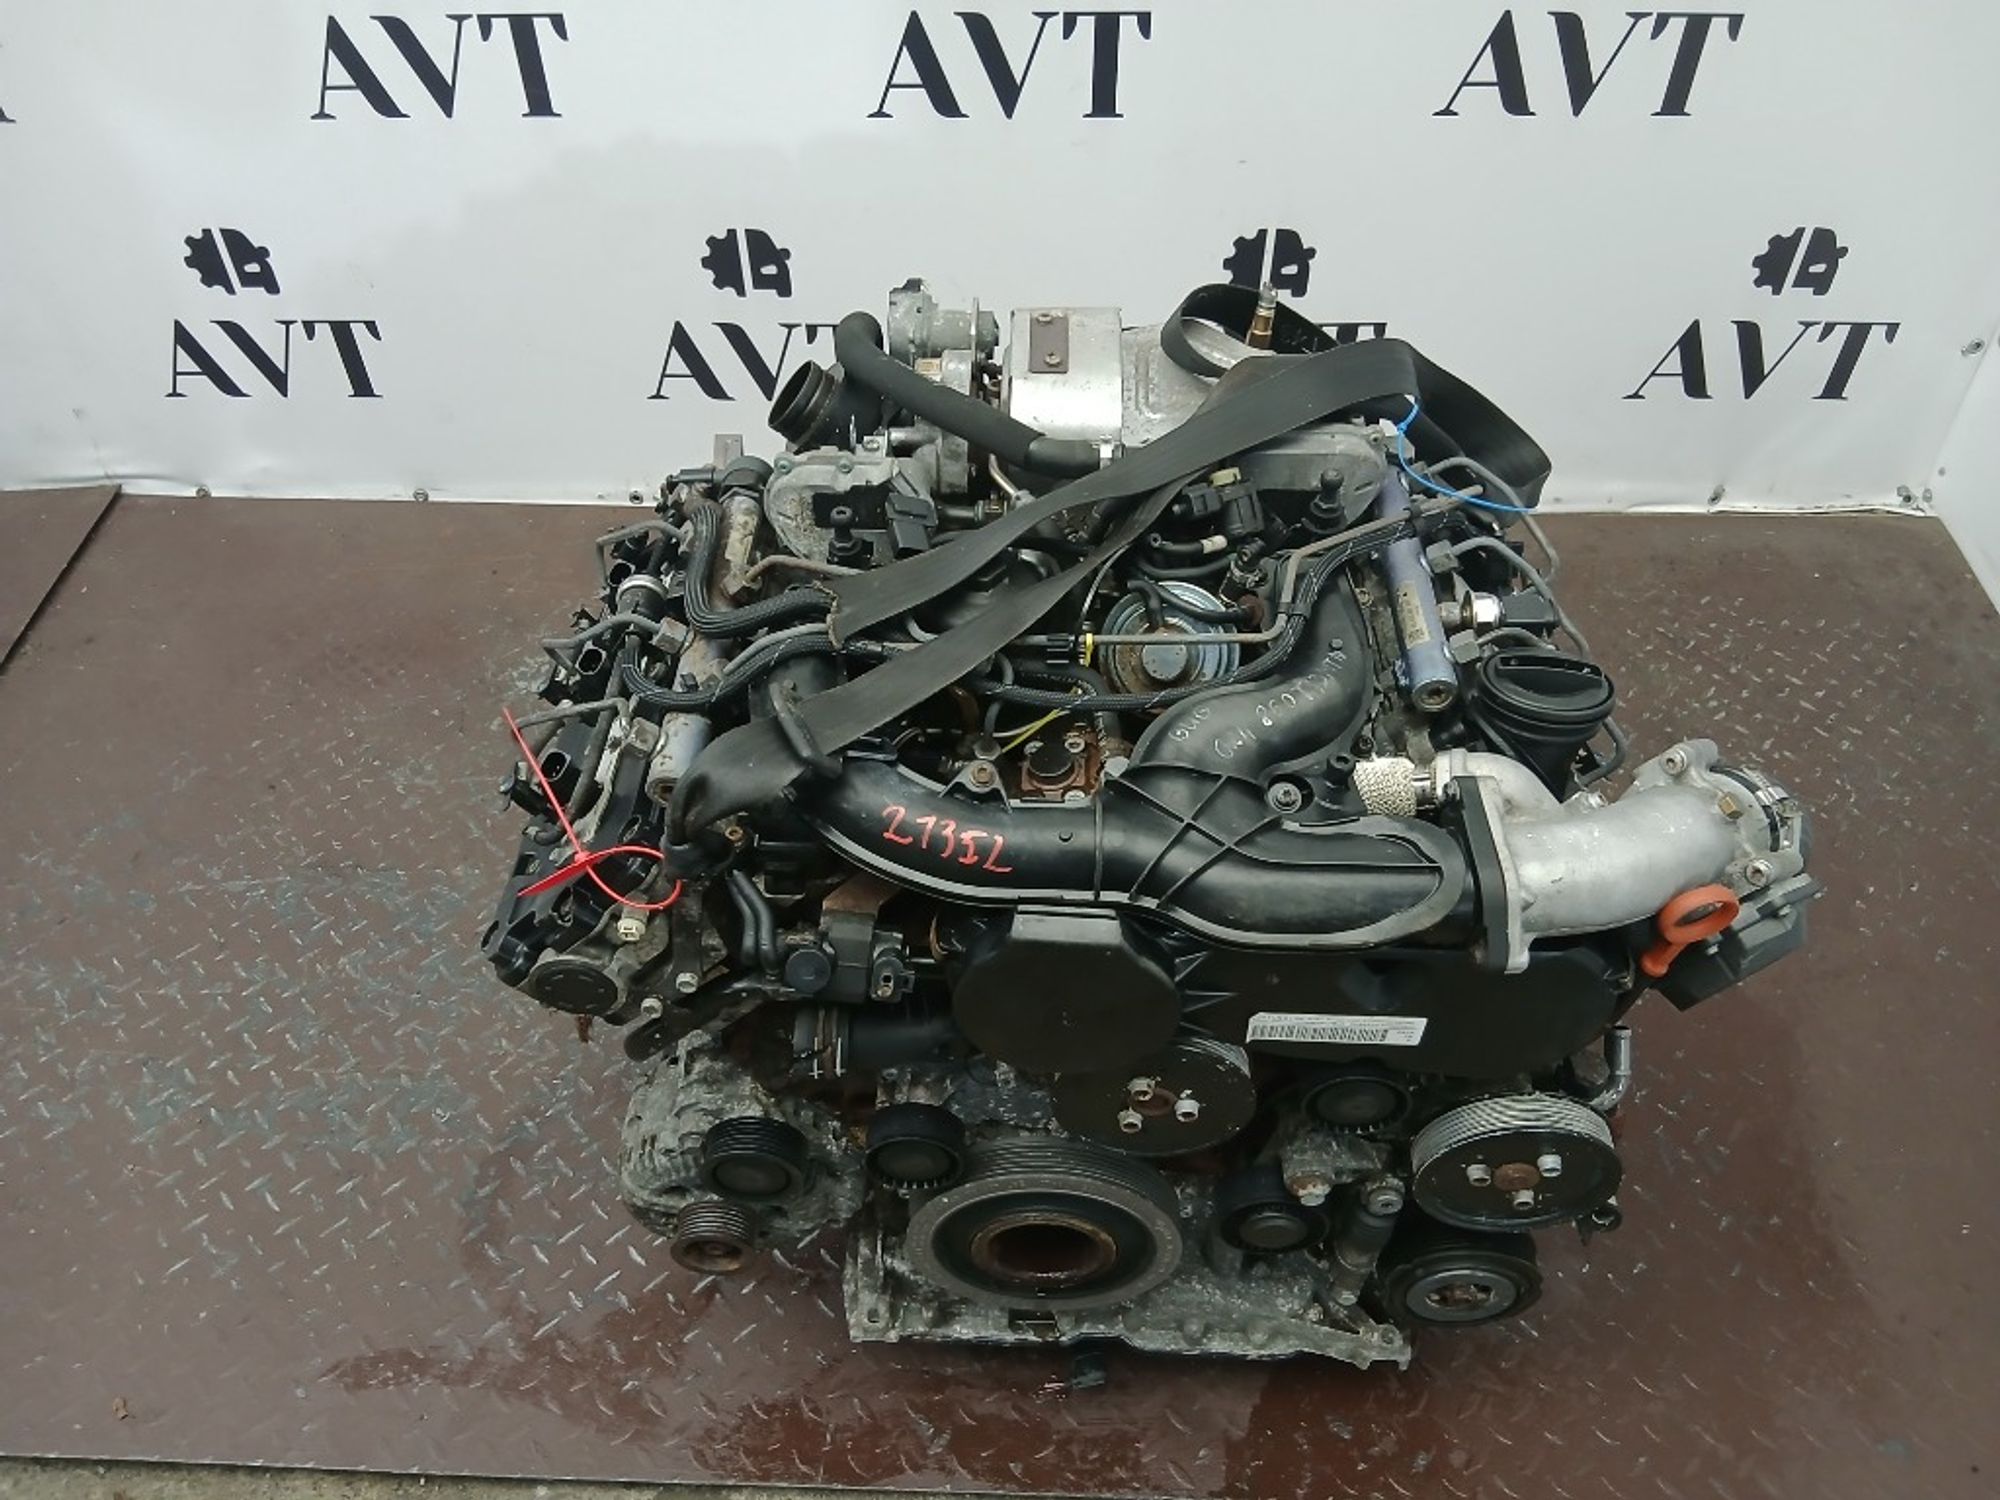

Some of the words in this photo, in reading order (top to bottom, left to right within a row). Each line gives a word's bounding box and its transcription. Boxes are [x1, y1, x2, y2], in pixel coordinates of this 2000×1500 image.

[310, 12, 569, 120] AVT
[866, 10, 1152, 120] AVT
[1431, 9, 1745, 118] AVT
[165, 319, 383, 398] AVT
[1622, 318, 1901, 400] AVT
